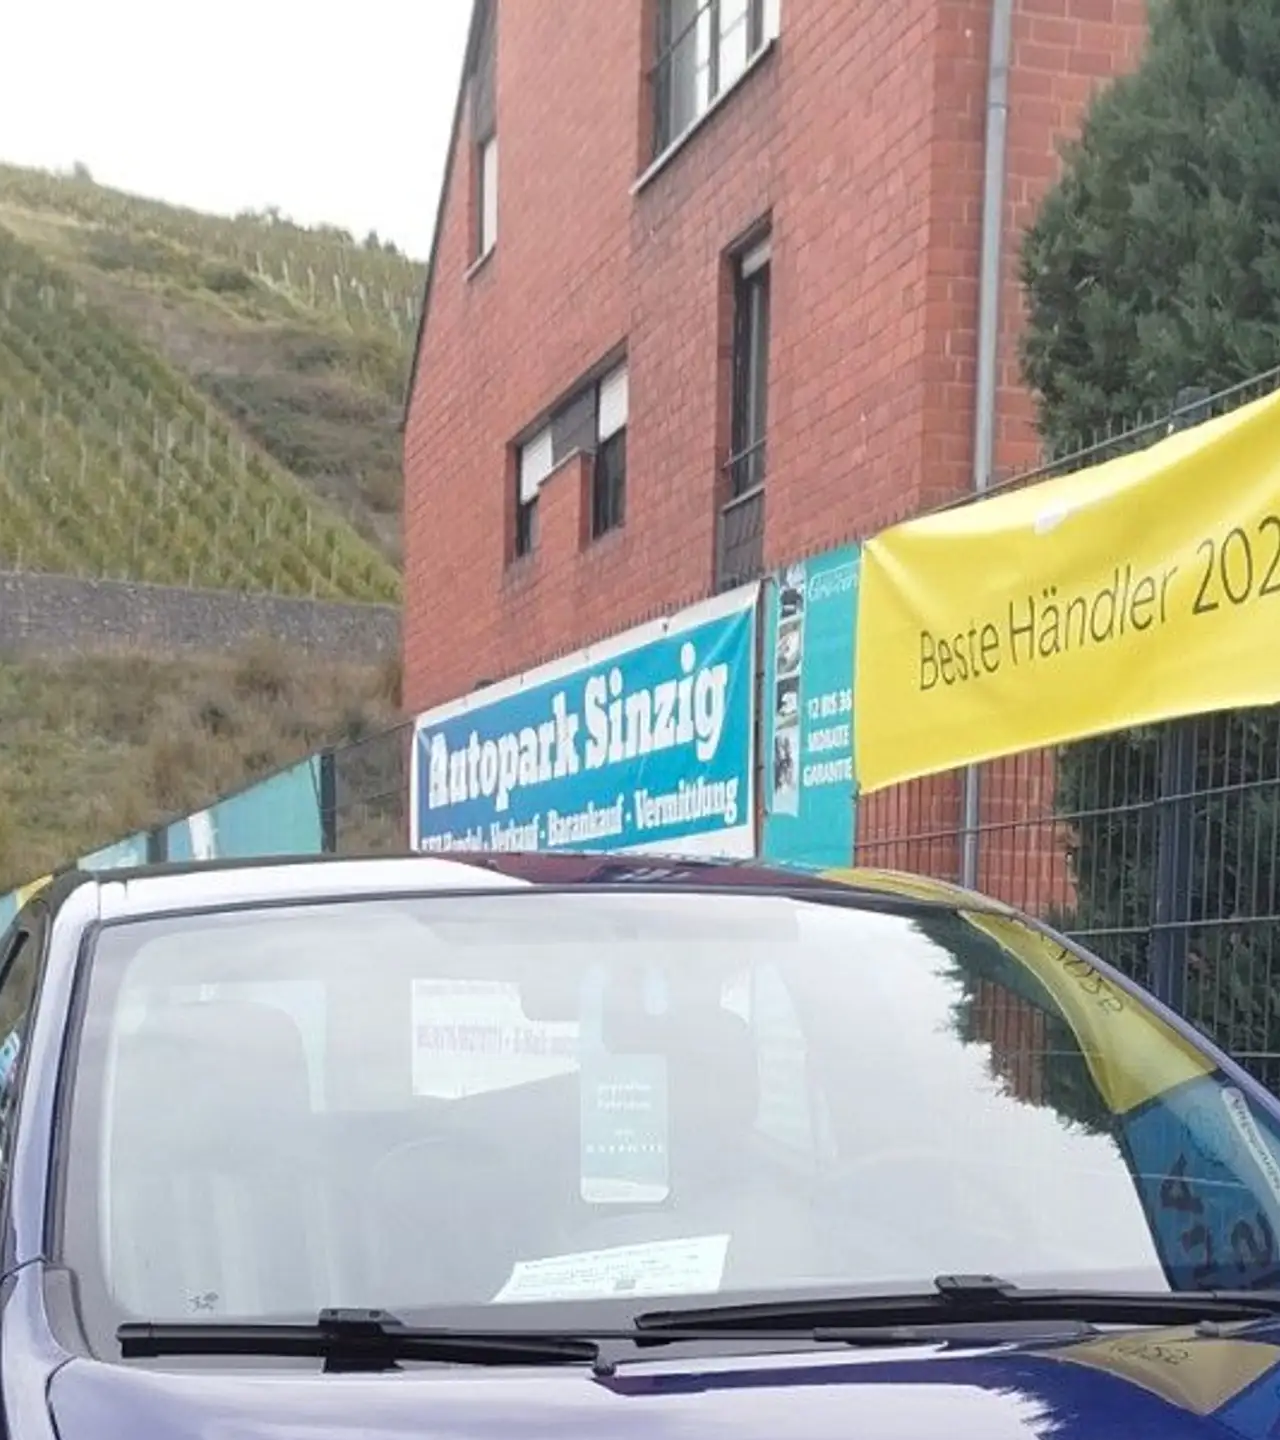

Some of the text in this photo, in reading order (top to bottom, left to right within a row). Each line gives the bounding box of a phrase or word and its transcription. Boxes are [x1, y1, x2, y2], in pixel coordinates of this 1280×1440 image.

[919, 619, 1000, 692] Beste
[1008, 564, 1179, 666] Händler
[429, 642, 729, 812] Autopark Sinzig
[633, 777, 739, 824] Vermittlung
